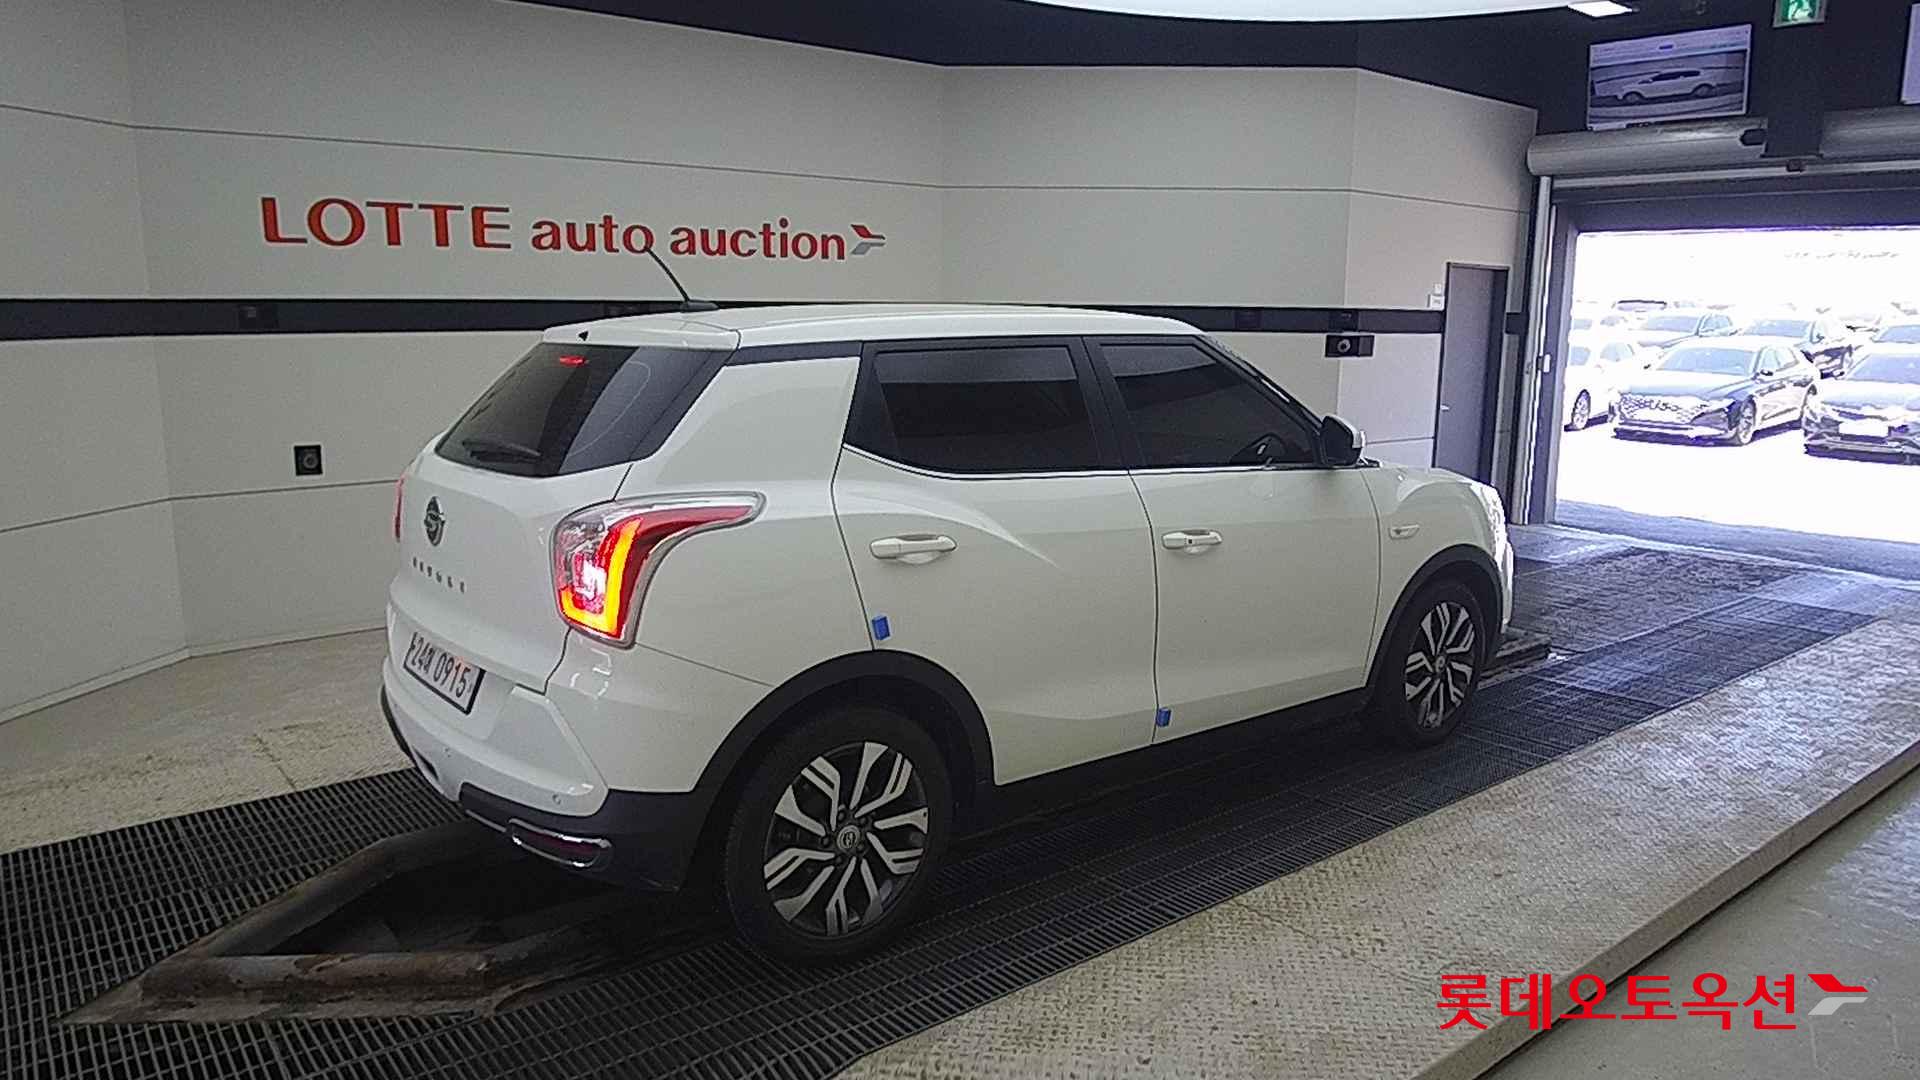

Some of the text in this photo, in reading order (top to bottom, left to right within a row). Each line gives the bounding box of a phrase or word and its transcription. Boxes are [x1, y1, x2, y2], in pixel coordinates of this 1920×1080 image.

[260, 196, 846, 260] LOTTE auto auction
